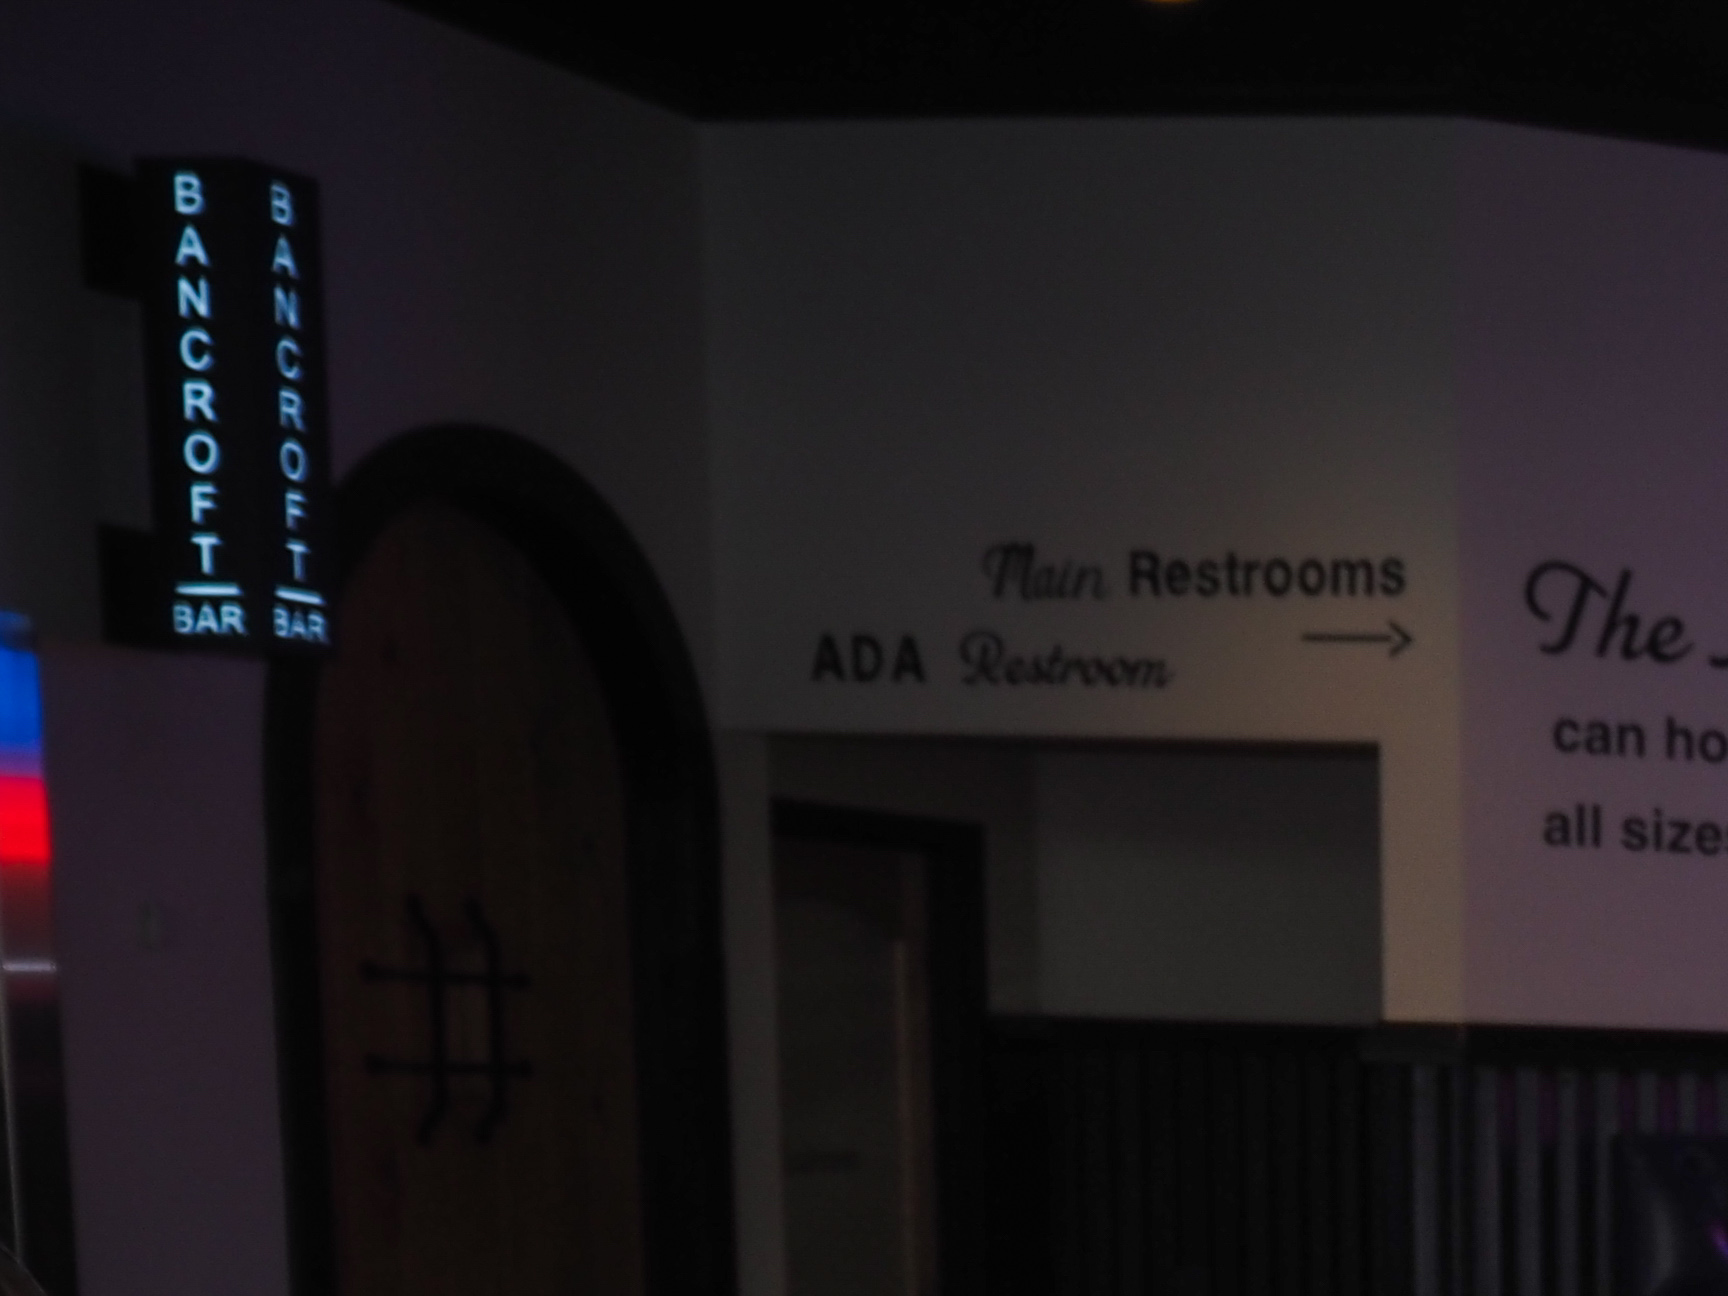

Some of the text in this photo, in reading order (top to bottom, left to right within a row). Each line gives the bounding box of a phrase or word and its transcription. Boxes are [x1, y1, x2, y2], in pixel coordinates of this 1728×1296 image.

[173, 171, 223, 576] BANCROFT
[269, 179, 311, 581] BANCROFT
[981, 541, 1406, 601] Main Restrooms
[172, 601, 248, 636] BAR
[272, 603, 327, 644] BAR
[1524, 559, 1694, 665] The
[811, 629, 1173, 689] ADA Restroom
[1553, 715, 1645, 759] can
[1543, 803, 1600, 848] all
